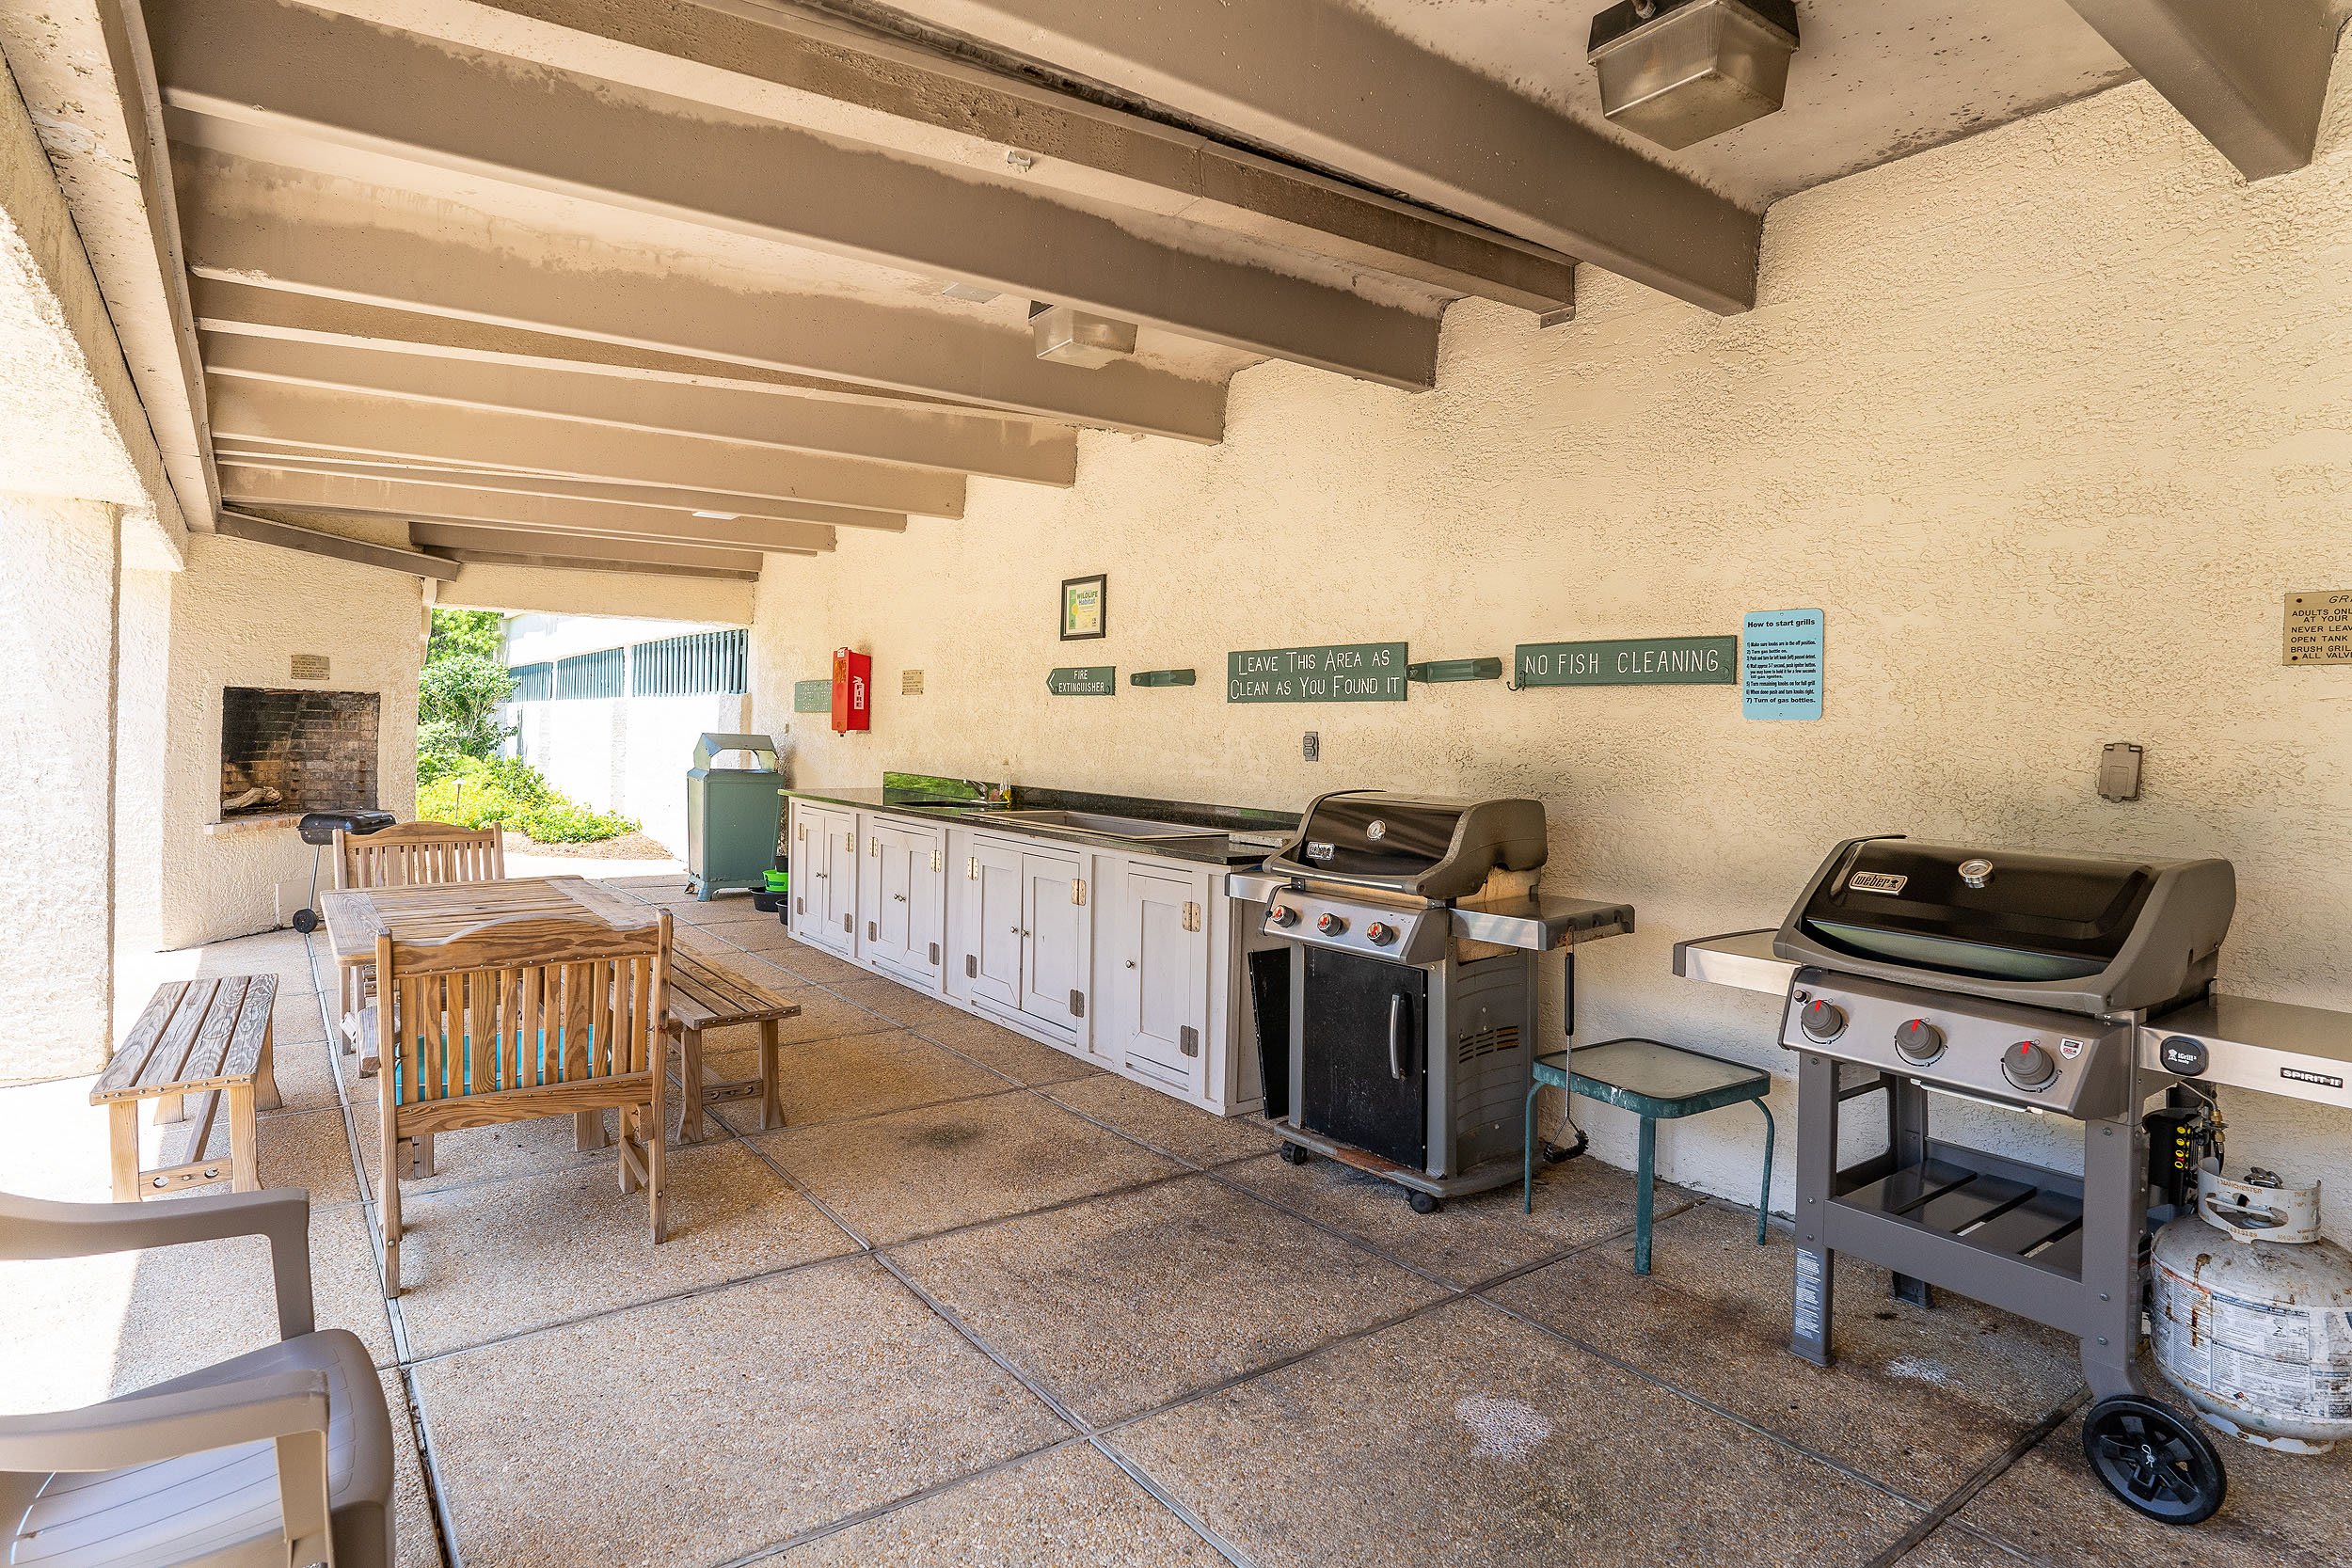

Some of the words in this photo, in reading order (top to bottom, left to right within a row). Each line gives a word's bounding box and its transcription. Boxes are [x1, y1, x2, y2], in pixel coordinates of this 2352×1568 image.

[1238, 655, 1279, 675] LEAVE
[1286, 652, 1316, 673] THIS
[1325, 650, 1362, 672] AREA
[1372, 650, 1391, 666] AS
[1525, 655, 1549, 675] NO
[1558, 653, 1598, 674] FISH
[1617, 649, 1719, 673] CLEANING
[1073, 670, 1089, 680] FIRE
[1058, 682, 1104, 692] EXTINGUISHER
[1231, 679, 1269, 700] CLEAN
[1276, 681, 1291, 695] AS
[1299, 676, 1326, 697] YOU
[1333, 675, 1378, 698] FOUND
[1387, 677, 1400, 694] IT
[1855, 875, 1890, 887] weber
[2283, 1070, 2326, 1083] SPIRIT
